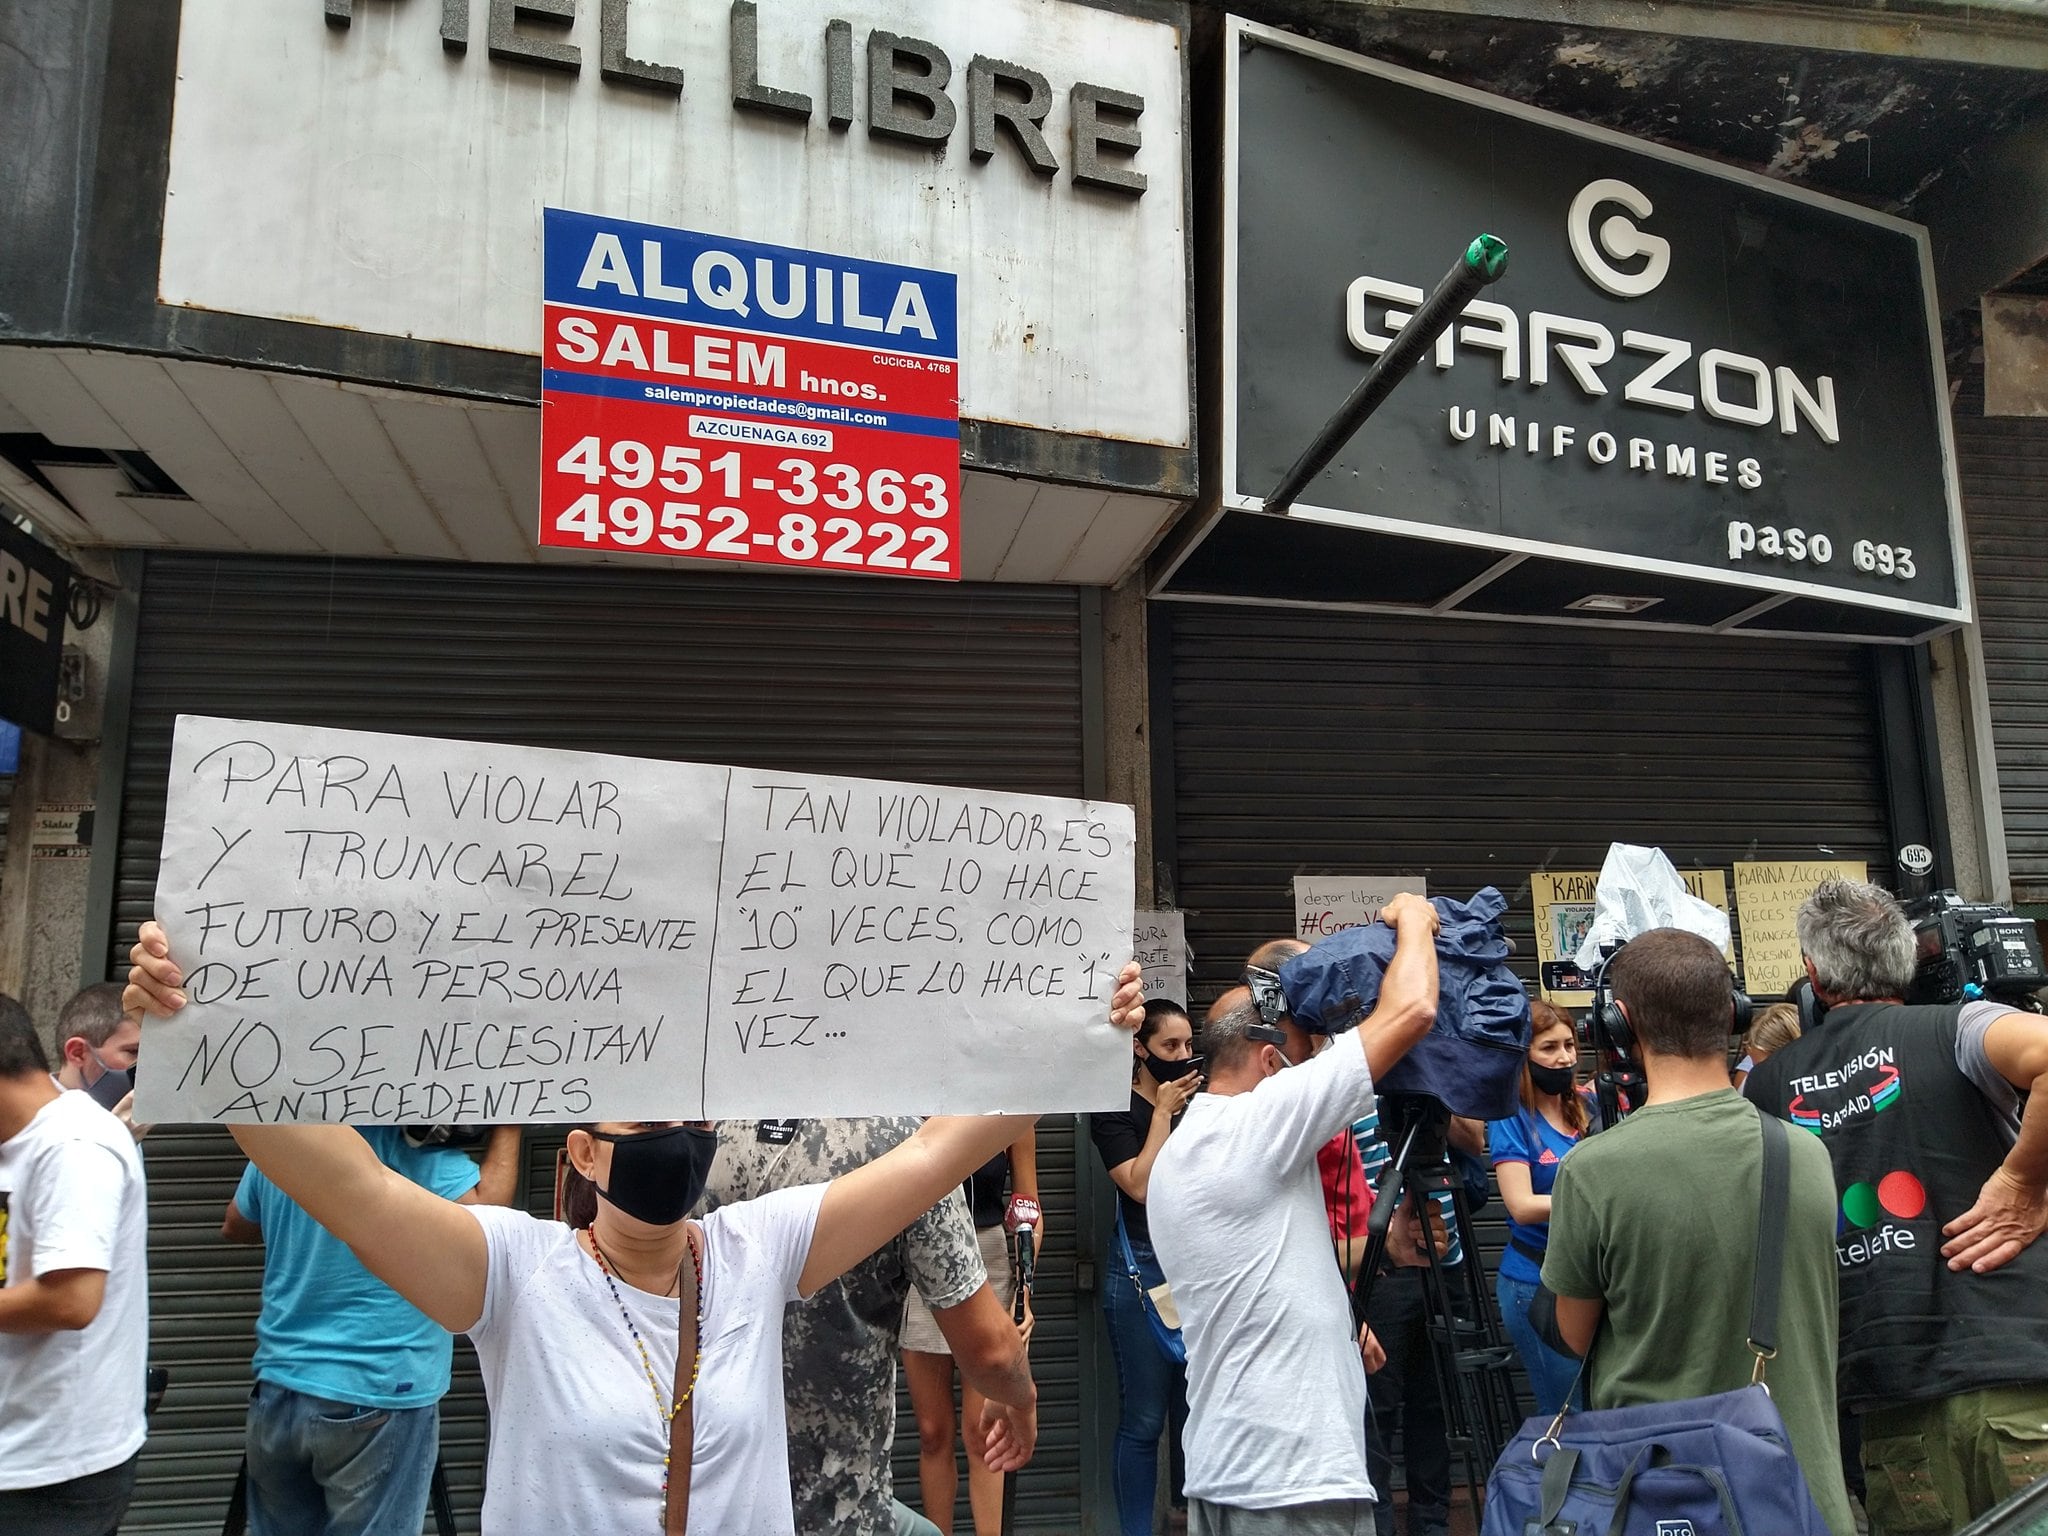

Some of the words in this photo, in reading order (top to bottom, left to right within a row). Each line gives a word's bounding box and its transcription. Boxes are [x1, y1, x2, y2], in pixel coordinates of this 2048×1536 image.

[732, 0, 1147, 197] LIBRE
[576, 233, 938, 340] ALQUILA
[556, 317, 786, 387] SALEM
[801, 369, 887, 402] hnos.
[873, 354, 925, 370] CUCICBA.
[927, 362, 951, 374] 4768
[1346, 276, 1840, 444] GARZON
[644, 385, 888, 427] salempropiedades@gmail.com
[696, 421, 798, 444] AZCUENAGA
[801, 433, 828, 447] 692
[1448, 405, 1763, 490] UNIFORMES
[556, 435, 948, 519] 4951-3363
[556, 493, 950, 572] 4952-8222
[1853, 539, 1917, 580] 693
[193, 741, 411, 819] PARA
[752, 785, 851, 833] TAN
[198, 826, 251, 890] Y
[285, 829, 553, 897] TRUNCAR
[560, 852, 634, 901] EL
[736, 852, 807, 899] EL
[830, 846, 917, 889] QUE
[939, 856, 983, 896] LO
[1002, 863, 1099, 903] HACE
[1906, 848, 1927, 863] 693
[1351, 890, 1384, 906] libre
[183, 902, 397, 956] FUTURO
[417, 910, 440, 955] Y
[451, 911, 515, 944] EL
[526, 907, 699, 952] PRESENTE
[738, 905, 803, 951] "10"
[986, 914, 1083, 948] COMO
[182, 958, 280, 1005] DE
[298, 953, 393, 1000] UNA
[412, 959, 623, 1005] PERSONA
[732, 967, 795, 1006] EL
[823, 963, 911, 1002] QUE
[917, 960, 964, 996] LO
[982, 959, 1066, 998] HACE
[176, 1017, 282, 1092] NO
[292, 1024, 395, 1087] SE
[1789, 1046, 1894, 1096] TELEVISIÓN
[213, 1077, 593, 1124] ANTECEDENTES
[1834, 1224, 1916, 1267] telefe
